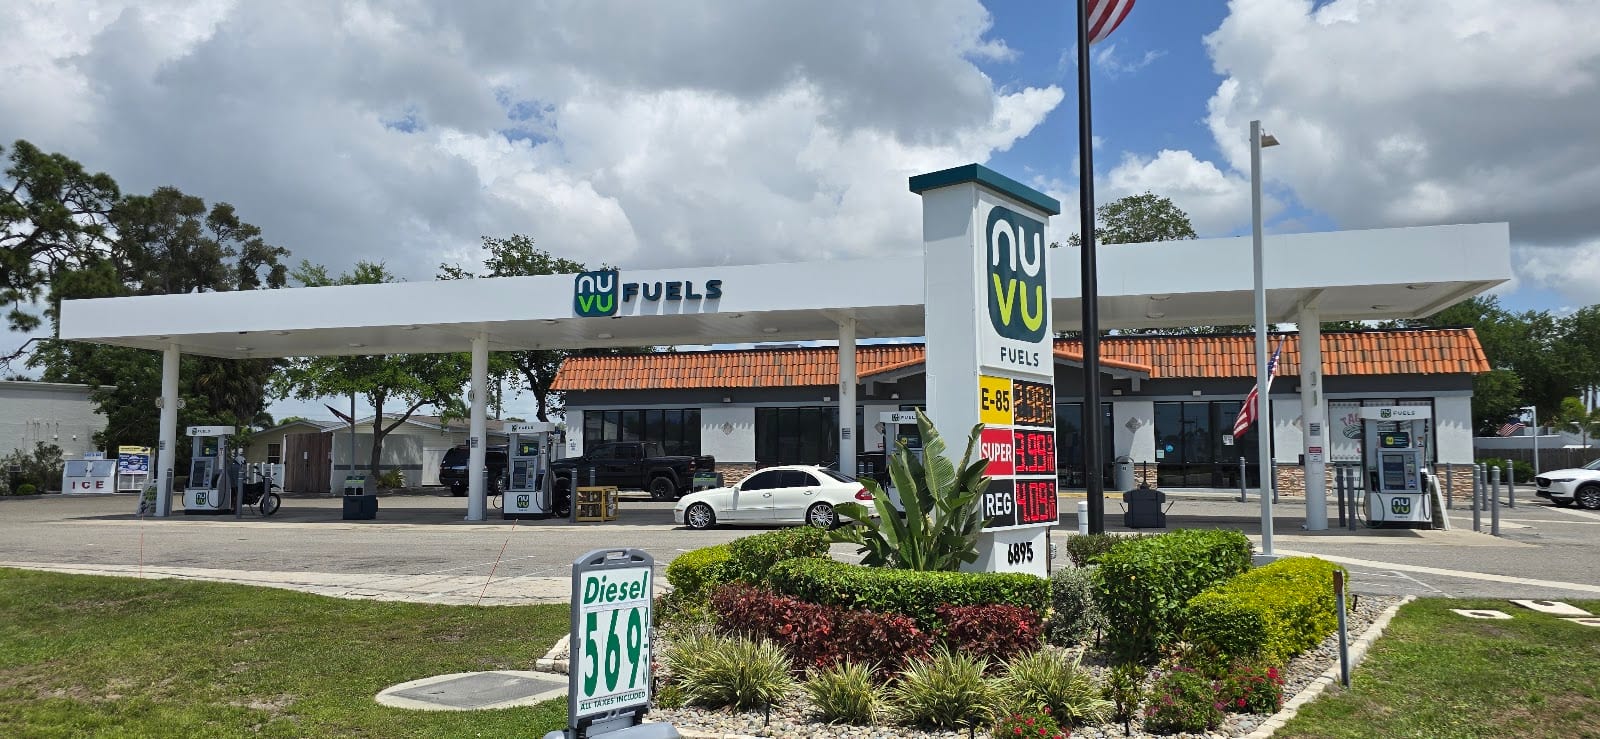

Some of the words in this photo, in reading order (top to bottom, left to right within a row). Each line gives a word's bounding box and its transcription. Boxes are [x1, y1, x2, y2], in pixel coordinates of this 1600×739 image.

[623, 280, 722, 302] FUELS
[1000, 346, 1039, 367] FUELS
[981, 387, 1010, 412] E-85
[981, 442, 1012, 462] SUPER
[1014, 433, 1047, 472] 3.99
[72, 480, 105, 490] ICE
[985, 492, 1012, 516] REG
[1015, 482, 1049, 522] 4.09
[1007, 541, 1034, 566] 6895
[584, 571, 648, 604] Diesel
[584, 607, 642, 697] 569
[580, 701, 591, 711] ALL
[594, 697, 614, 708] TAXES
[616, 691, 646, 704] INCLUDED
